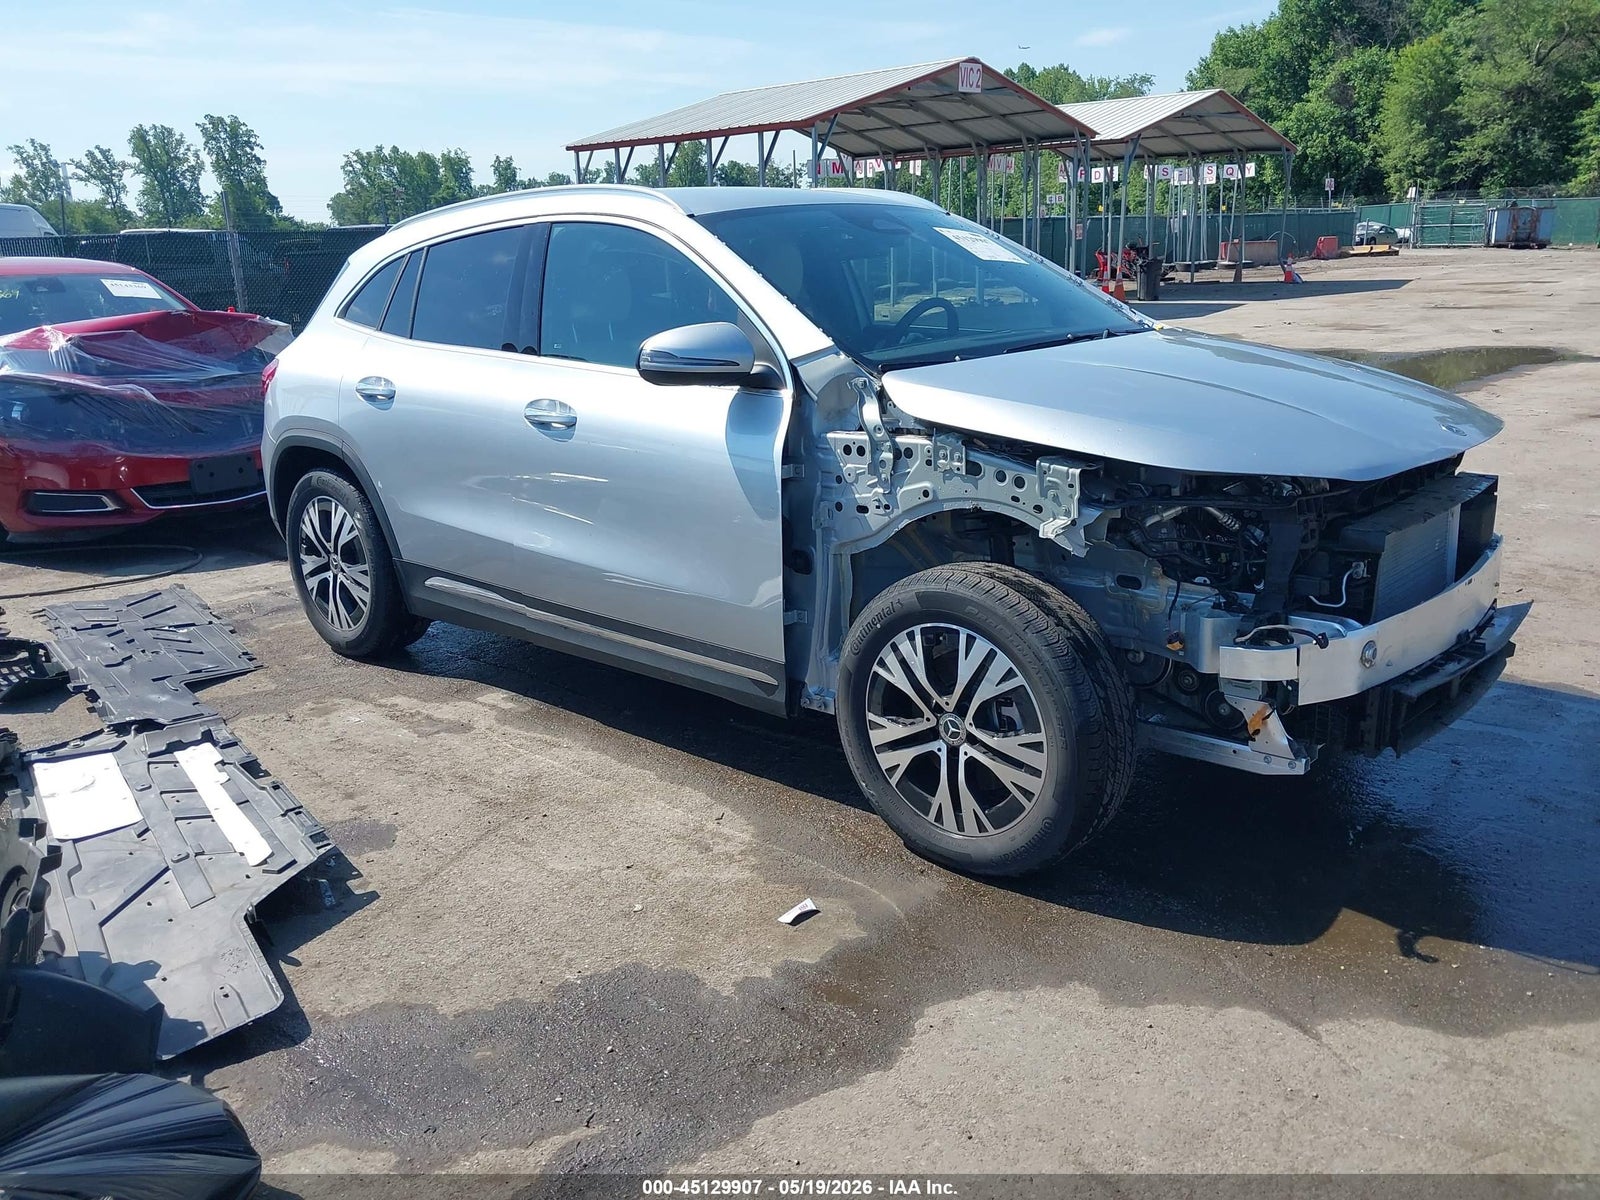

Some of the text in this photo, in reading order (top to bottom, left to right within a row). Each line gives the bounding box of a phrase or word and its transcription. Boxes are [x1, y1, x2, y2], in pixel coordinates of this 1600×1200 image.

[960, 66, 982, 88] VIC 2
[832, 162, 844, 174] M
[1162, 167, 1169, 176] S
[1206, 165, 1214, 175] S
[1225, 167, 1235, 177] Q
[1094, 170, 1101, 180] D
[850, 601, 896, 656] Continental
